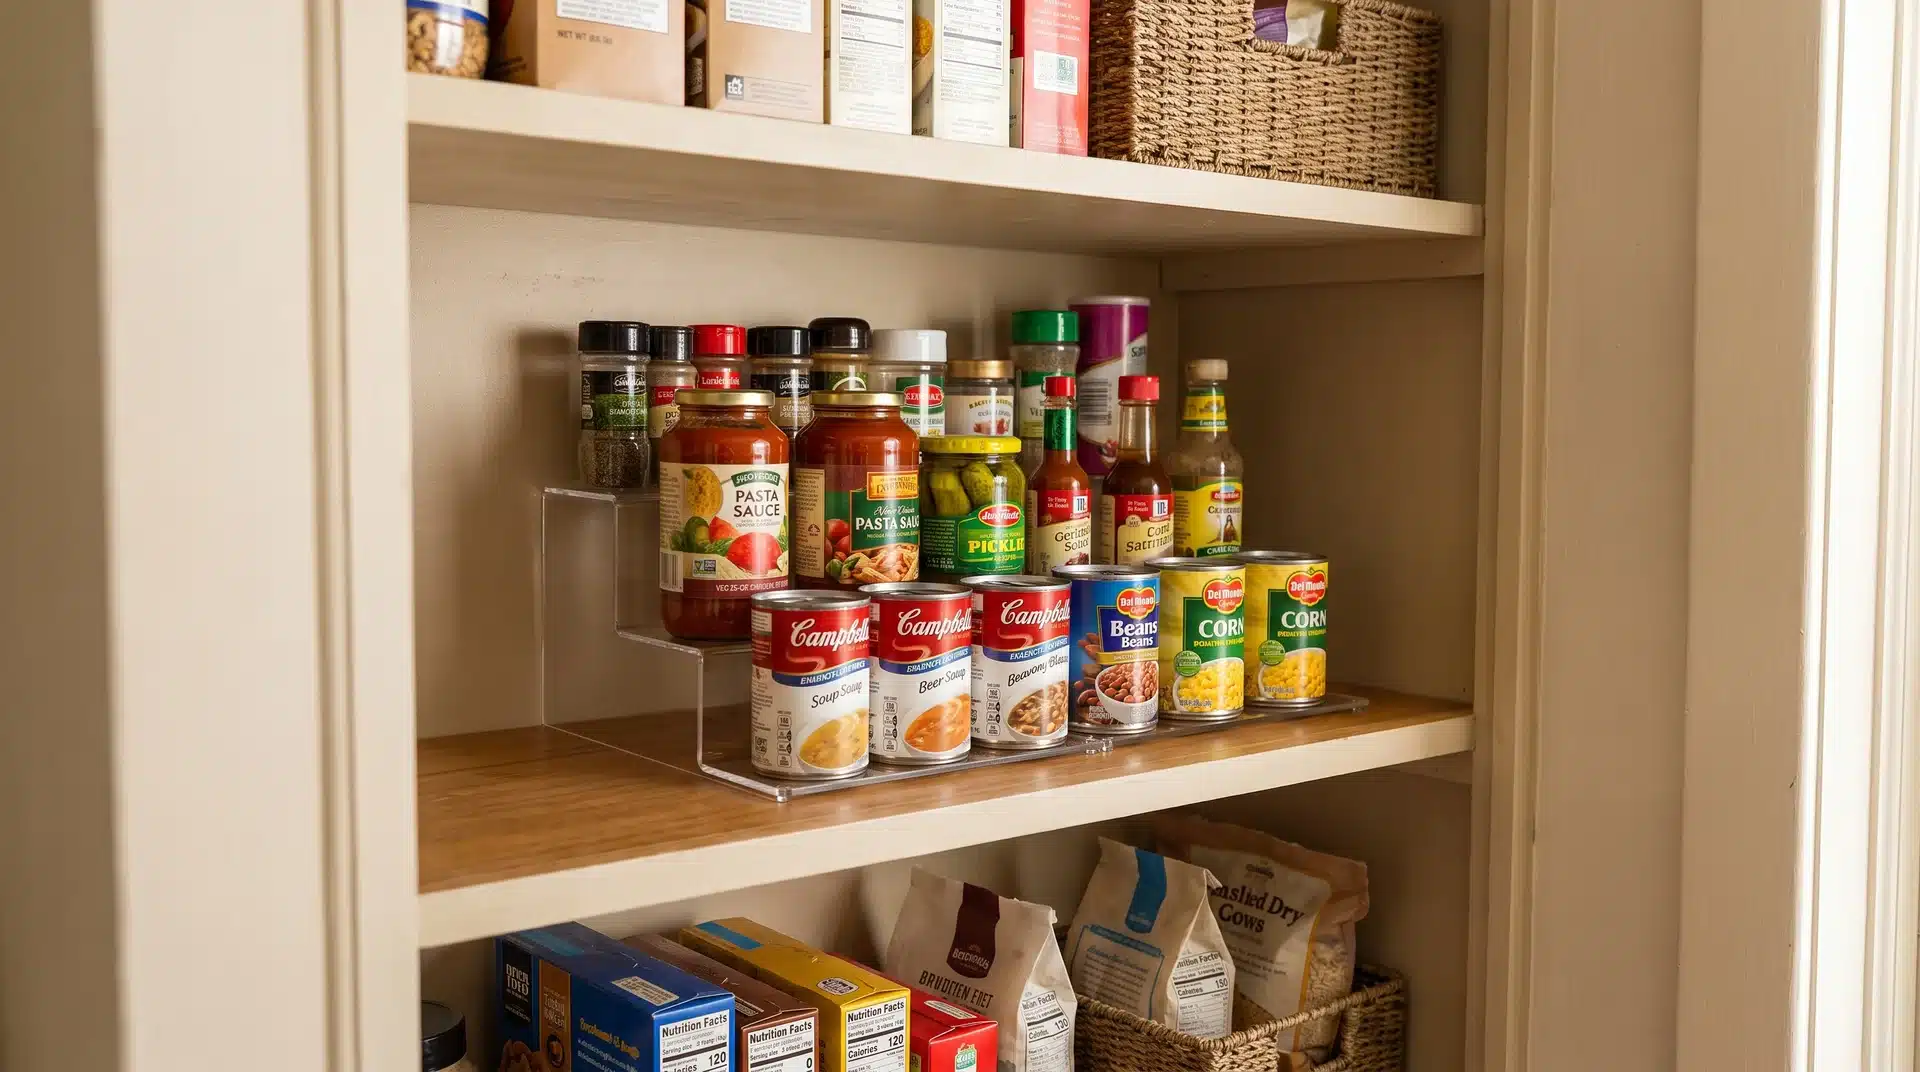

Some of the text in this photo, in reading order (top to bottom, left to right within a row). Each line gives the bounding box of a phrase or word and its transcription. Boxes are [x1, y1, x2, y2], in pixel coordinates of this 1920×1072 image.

[736, 489, 779, 503] PASTA
[733, 503, 780, 518] SAUCE
[855, 517, 898, 531] PASTA
[1207, 589, 1221, 600] Del
[1198, 616, 1244, 638] CORN
[1281, 609, 1327, 629] CORN
[1110, 620, 1158, 637] Beans
[1121, 636, 1154, 649] Beans
[919, 676, 944, 694] Beer
[811, 690, 840, 709] Soup
[1218, 903, 1265, 933] Cows
[1267, 895, 1304, 928] Dry
[847, 1001, 905, 1023] Nutrition Facts
[662, 1014, 728, 1038] Nutrition Facts
[749, 1021, 813, 1044] Nutrition Facts
[888, 1034, 904, 1047] 120
[708, 1051, 727, 1066] 120
[806, 1057, 813, 1069] 0
